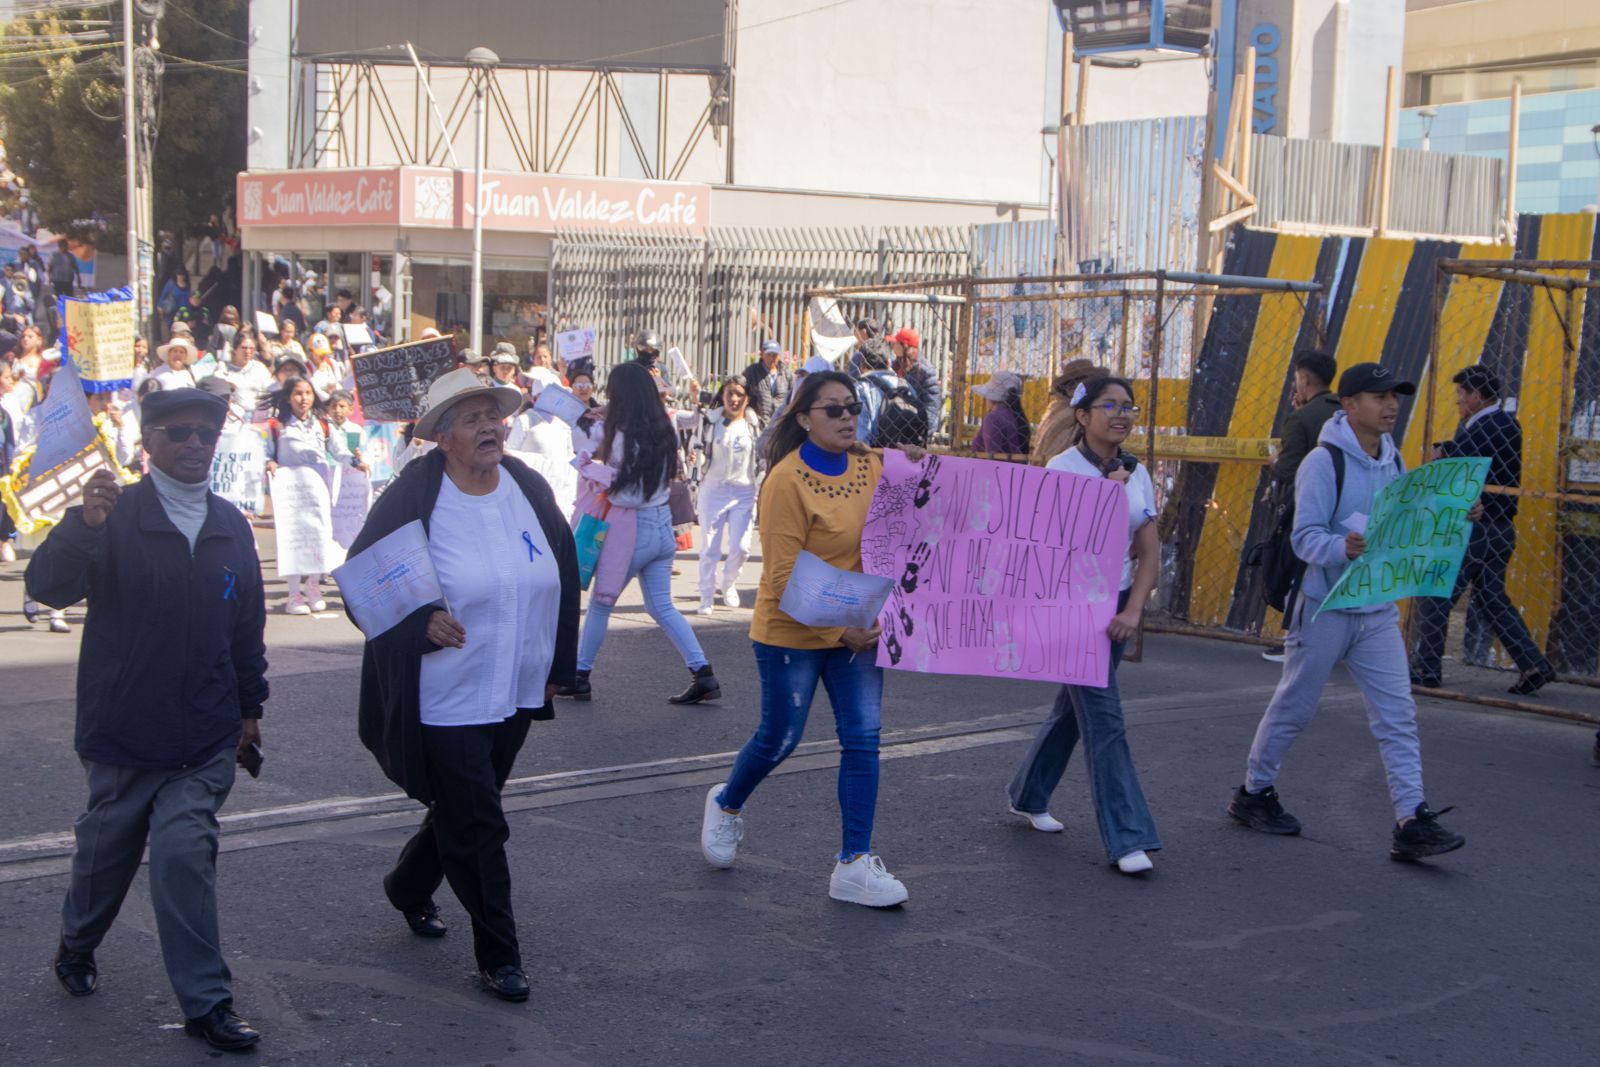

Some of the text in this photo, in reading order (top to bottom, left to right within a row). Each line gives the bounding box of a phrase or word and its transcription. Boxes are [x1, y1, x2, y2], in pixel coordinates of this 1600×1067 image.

[267, 175, 393, 217] Juan Valdez Café
[464, 180, 697, 225] Juan Valdez Café
[943, 466, 1120, 555] NI SILENCIO
[927, 538, 1072, 600] NI PAZ HASTA
[925, 600, 1098, 681] QUE HAYA JUSTICIA
